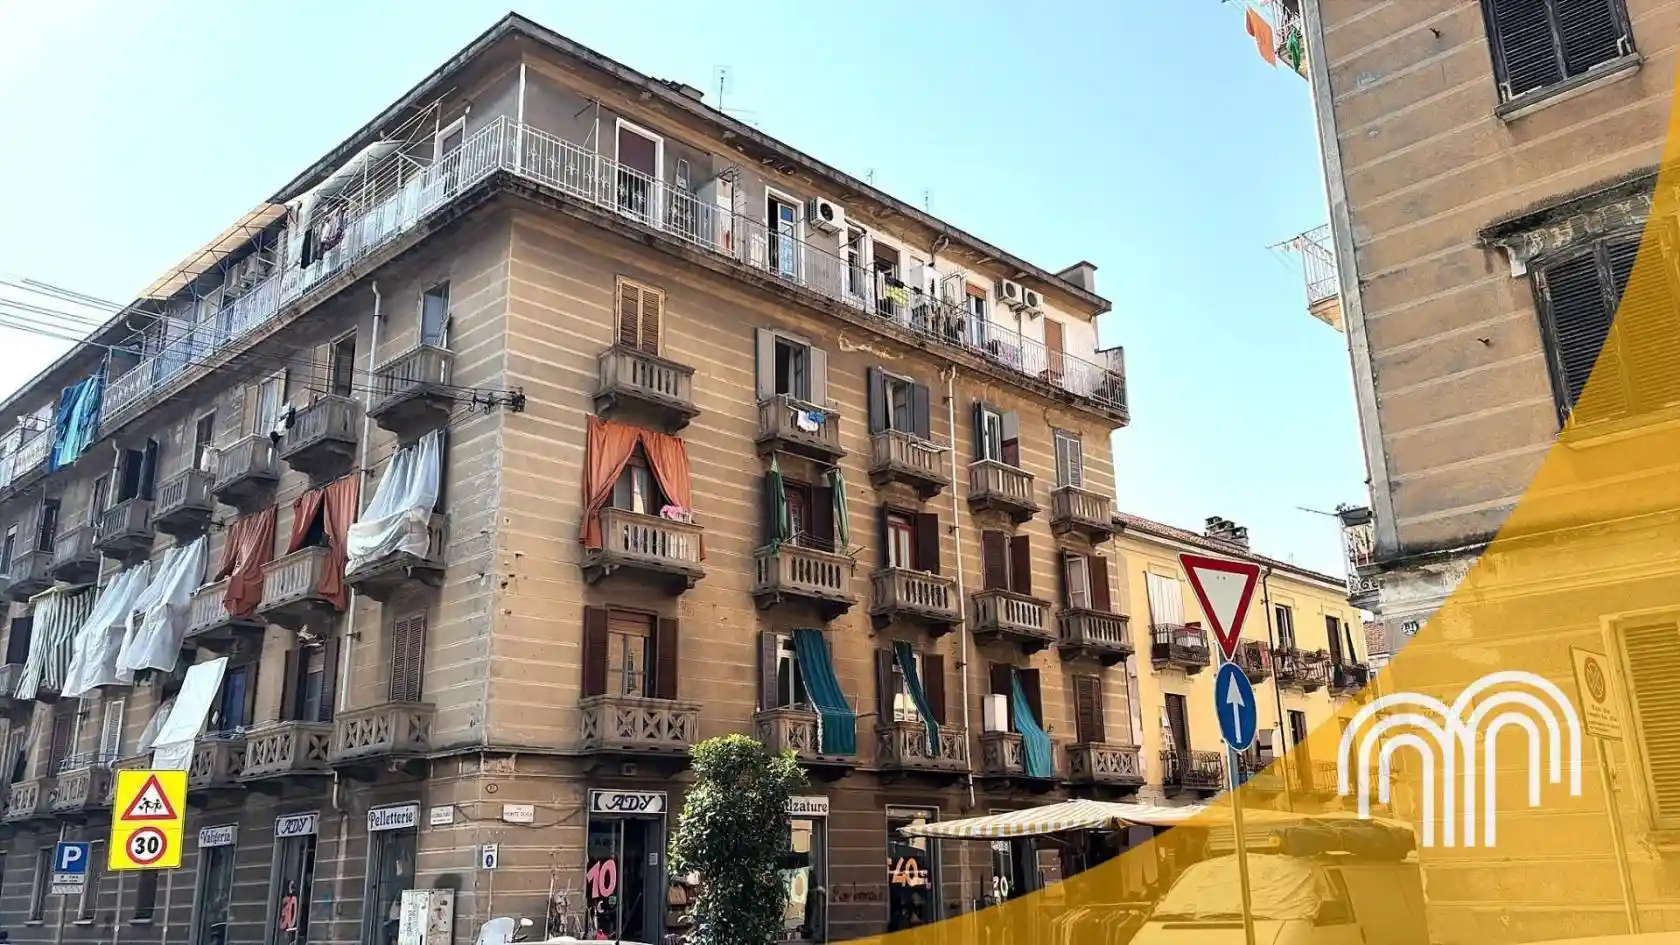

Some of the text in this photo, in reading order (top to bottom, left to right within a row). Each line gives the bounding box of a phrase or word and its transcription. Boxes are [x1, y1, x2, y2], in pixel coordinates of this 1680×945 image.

[606, 794, 656, 811] ADY
[784, 798, 828, 813] lzature
[282, 818, 309, 835] ADY
[368, 807, 413, 829] Pelletterie
[135, 836, 159, 854] 30
[61, 846, 82, 870] P
[586, 859, 616, 899] 10
